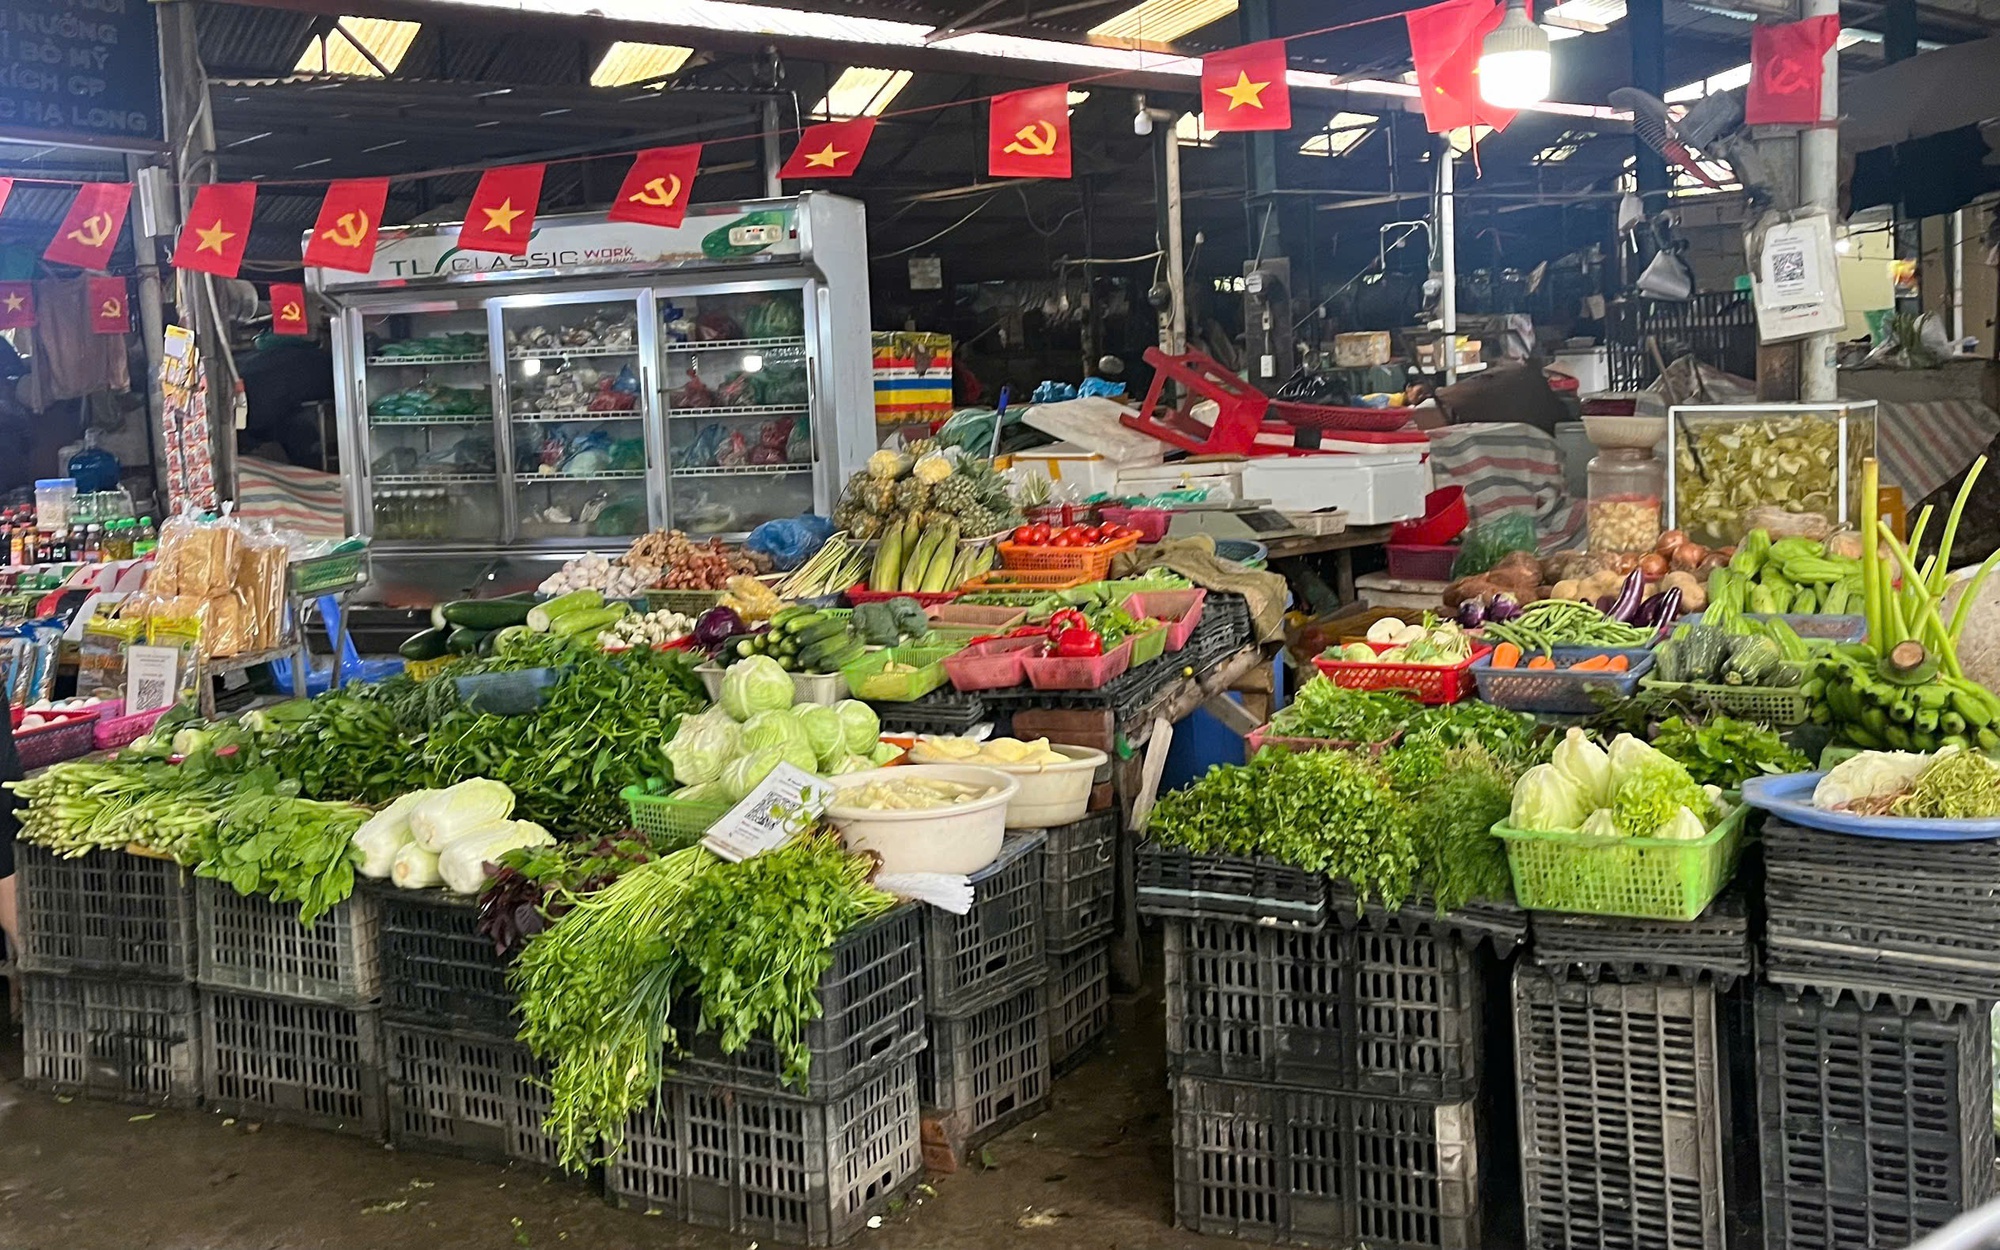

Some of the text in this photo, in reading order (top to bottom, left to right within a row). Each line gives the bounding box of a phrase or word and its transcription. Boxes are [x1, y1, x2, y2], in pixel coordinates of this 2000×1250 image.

[72, 105, 148, 132] LONG
[388, 246, 634, 277] TL CLASSIC WORK
